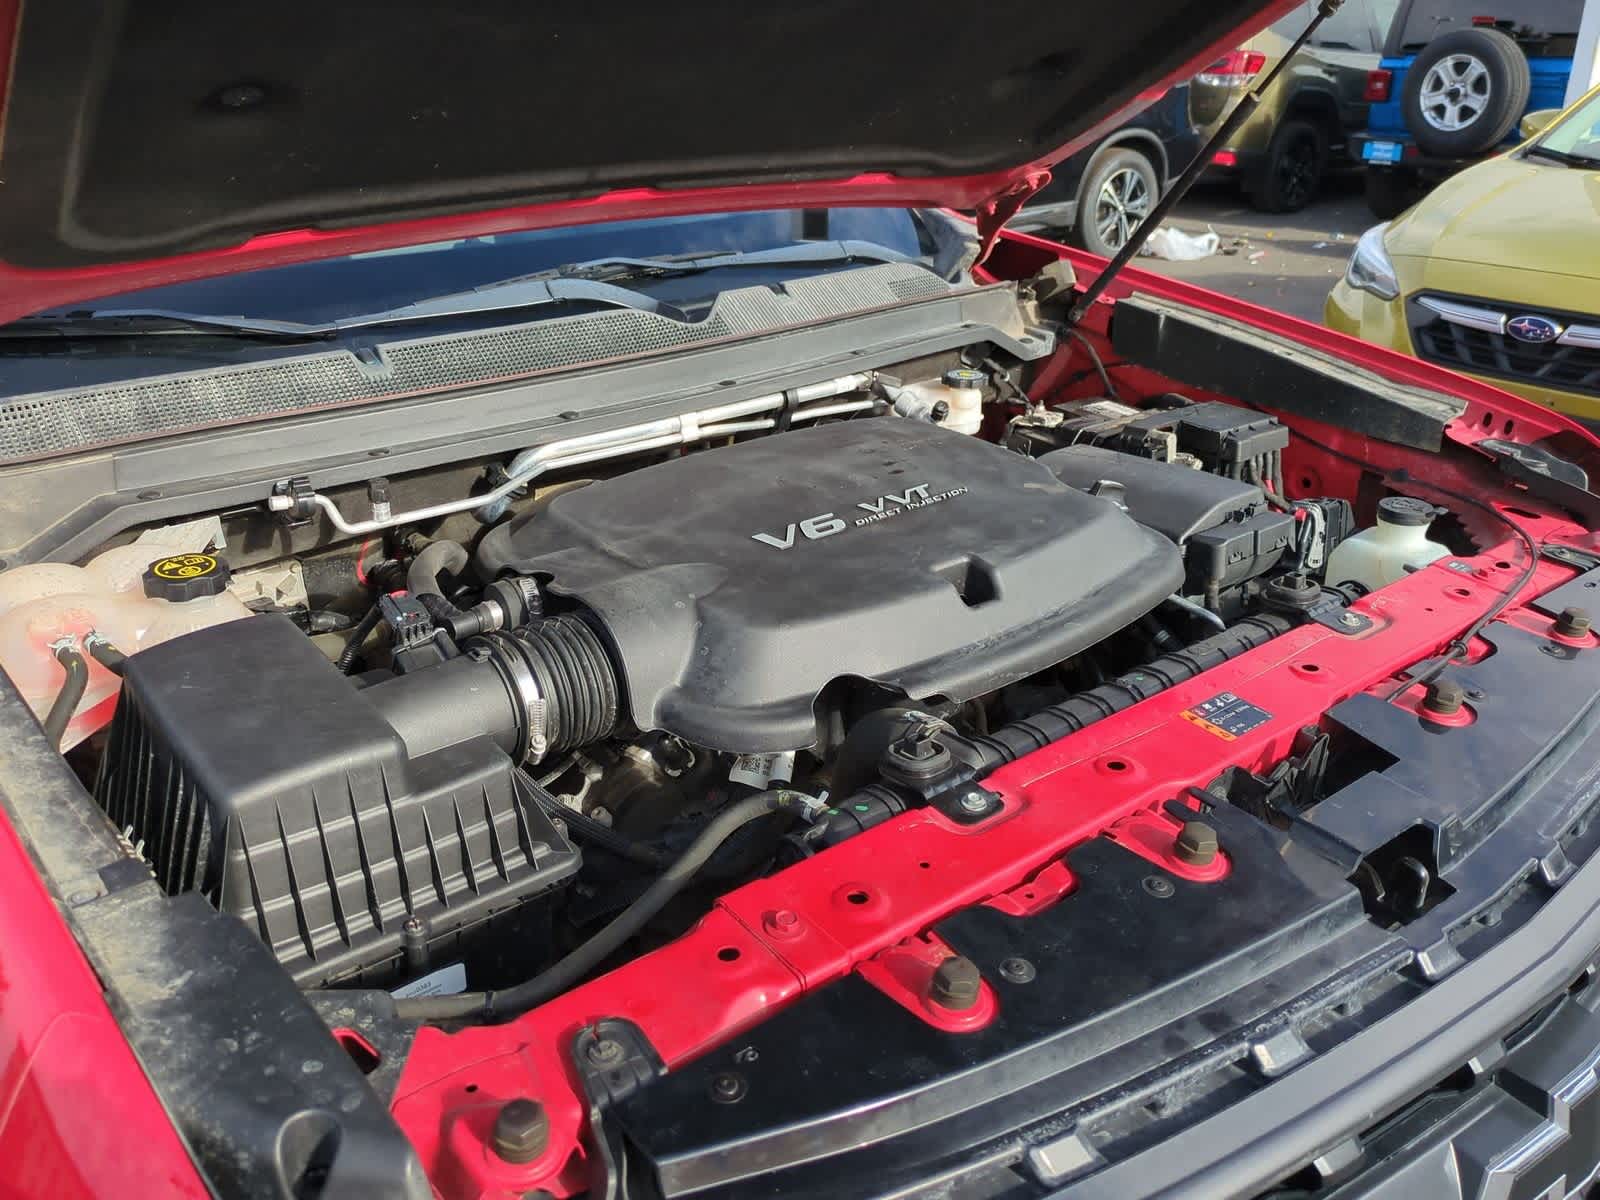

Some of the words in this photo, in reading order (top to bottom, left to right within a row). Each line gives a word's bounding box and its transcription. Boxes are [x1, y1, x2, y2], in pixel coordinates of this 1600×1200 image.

[855, 507, 901, 527] DIRECT
[906, 486, 968, 511] INJECTION
[856, 483, 929, 513] VVT
[751, 512, 847, 550] V6
